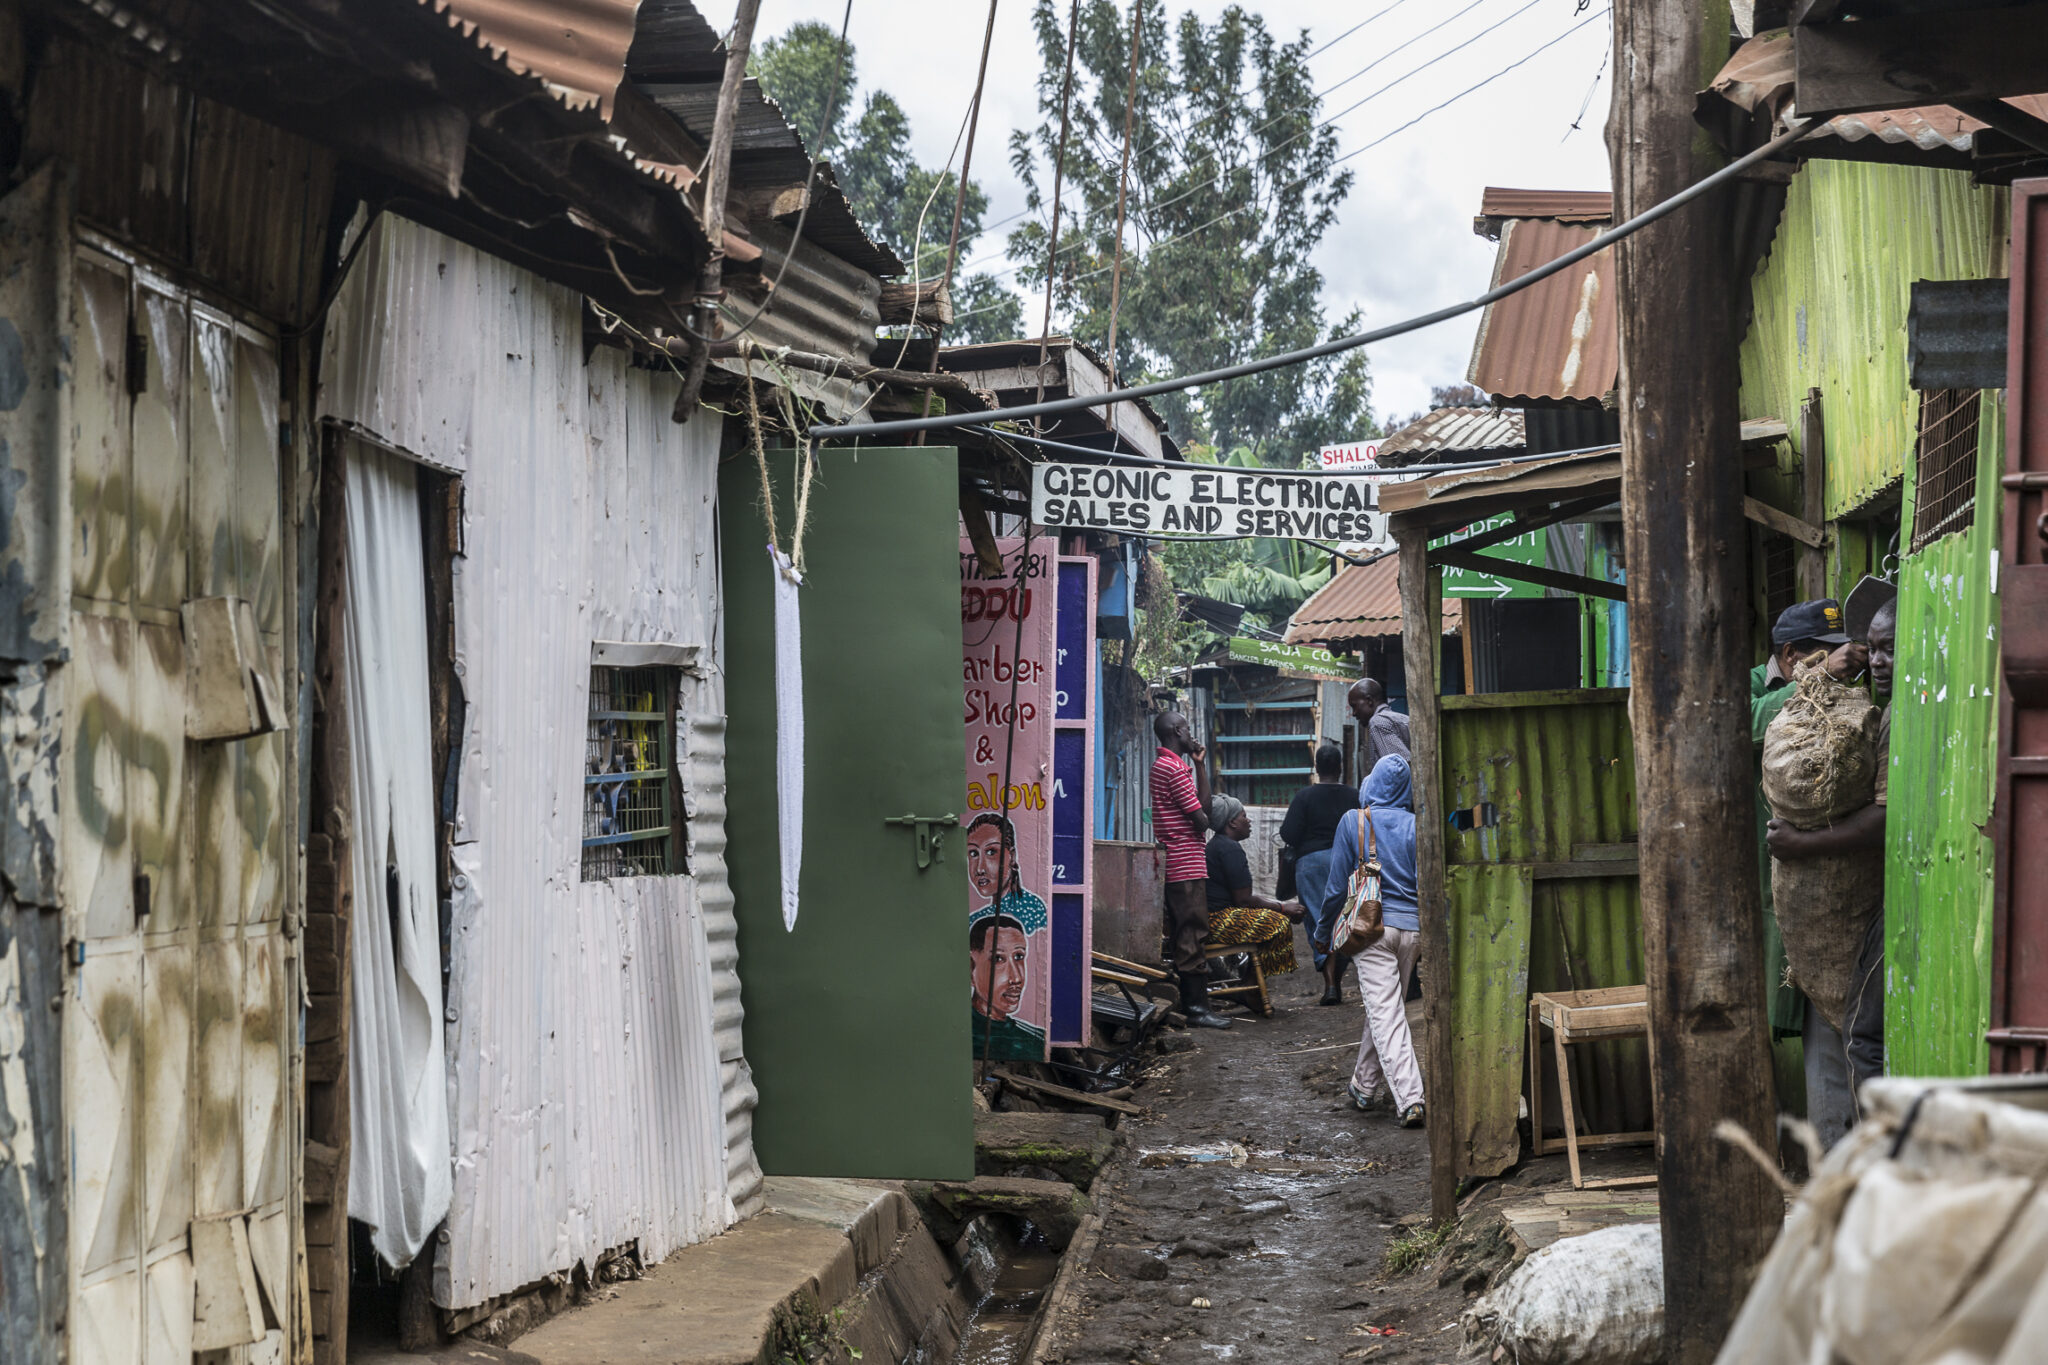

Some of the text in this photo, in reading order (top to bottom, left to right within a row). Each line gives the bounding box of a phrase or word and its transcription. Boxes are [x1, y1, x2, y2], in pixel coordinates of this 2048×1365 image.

[1323, 445, 1380, 465] SHALO
[1043, 465, 1381, 512] GEONIC ELECTRICAL
[1043, 499, 1373, 542] SALES AND SERVICES
[1012, 553, 1047, 579] 281
[963, 645, 1044, 684] arber
[1259, 642, 1302, 657] SAJA
[965, 689, 1036, 730] Shop
[974, 735, 995, 764] &
